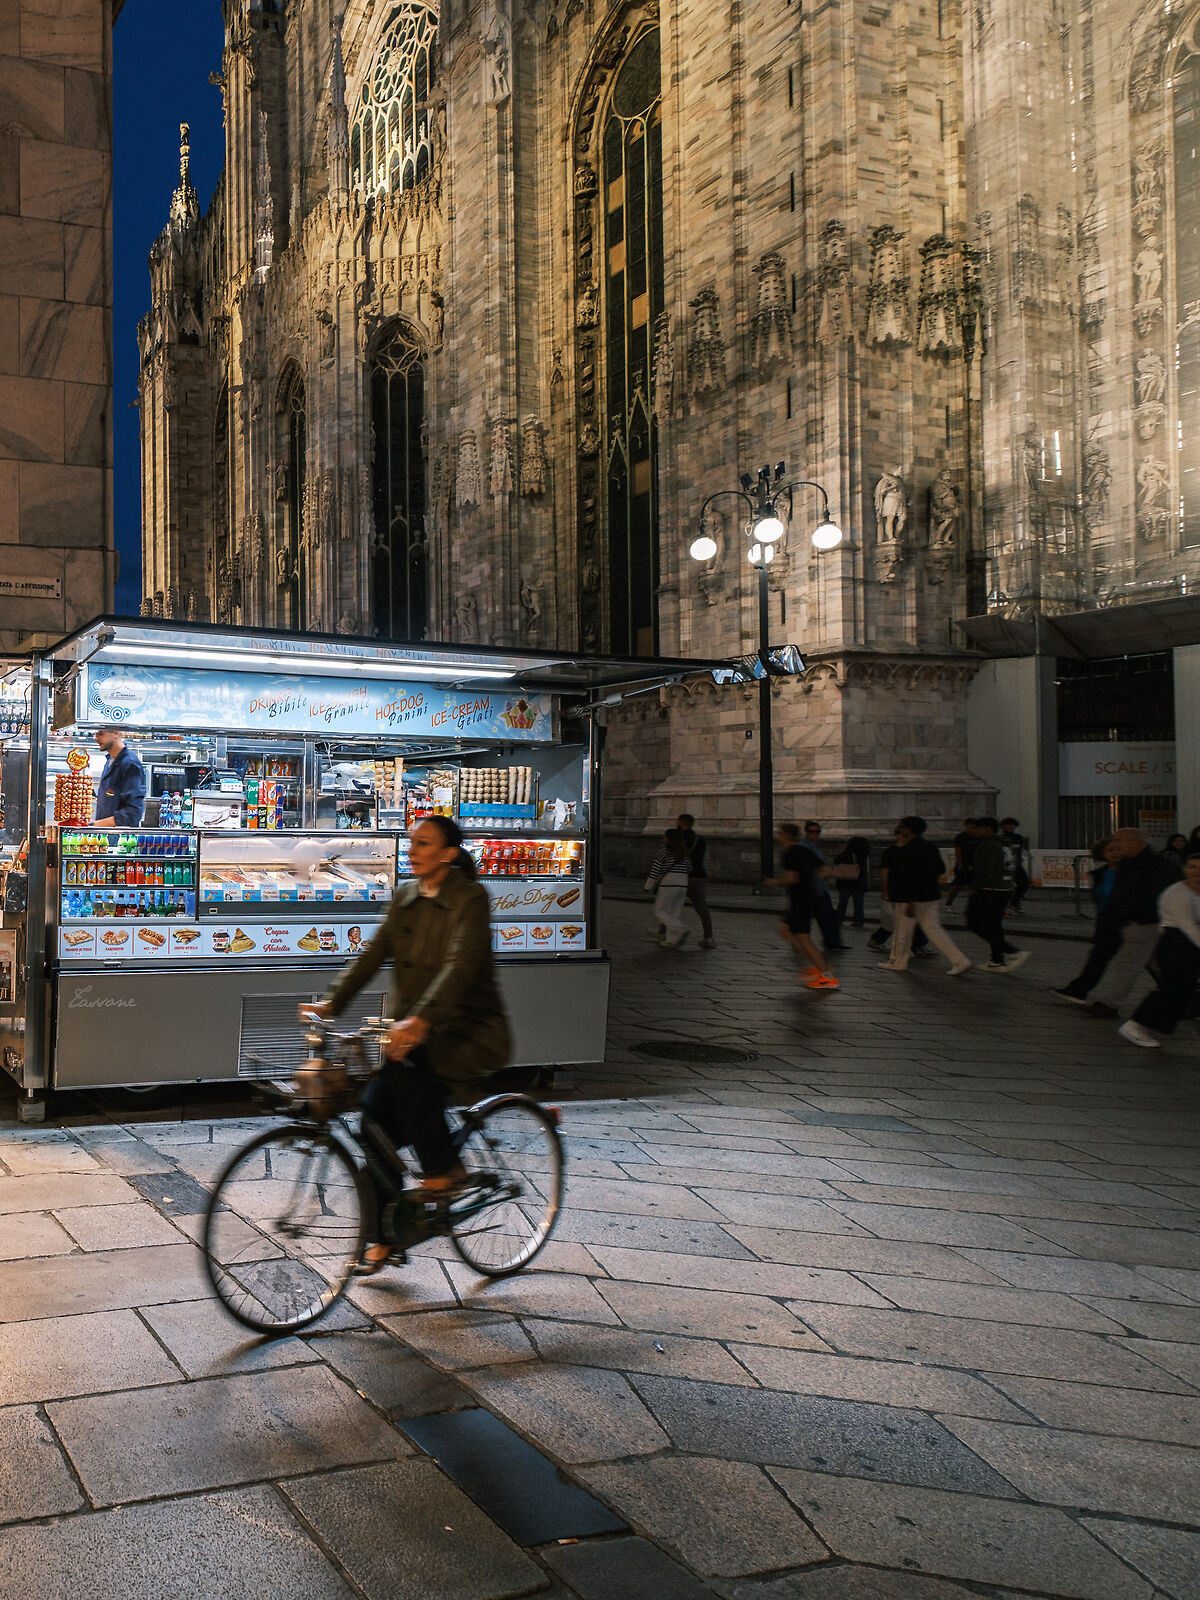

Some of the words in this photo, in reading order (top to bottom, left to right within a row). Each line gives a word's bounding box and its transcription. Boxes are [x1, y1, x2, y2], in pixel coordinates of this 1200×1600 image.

[269, 694, 308, 718] Bibite
[376, 693, 424, 720] HOT-DOG
[388, 702, 428, 727] Panini
[431, 696, 490, 727] ICE-CREAM
[457, 706, 493, 730] Gelati
[1095, 761, 1149, 774] SCALE
[1043, 862, 1087, 871] TICKT
[489, 888, 557, 914] Hot-Dog
[264, 927, 289, 937] Crepes
[263, 944, 290, 953] Nutella
